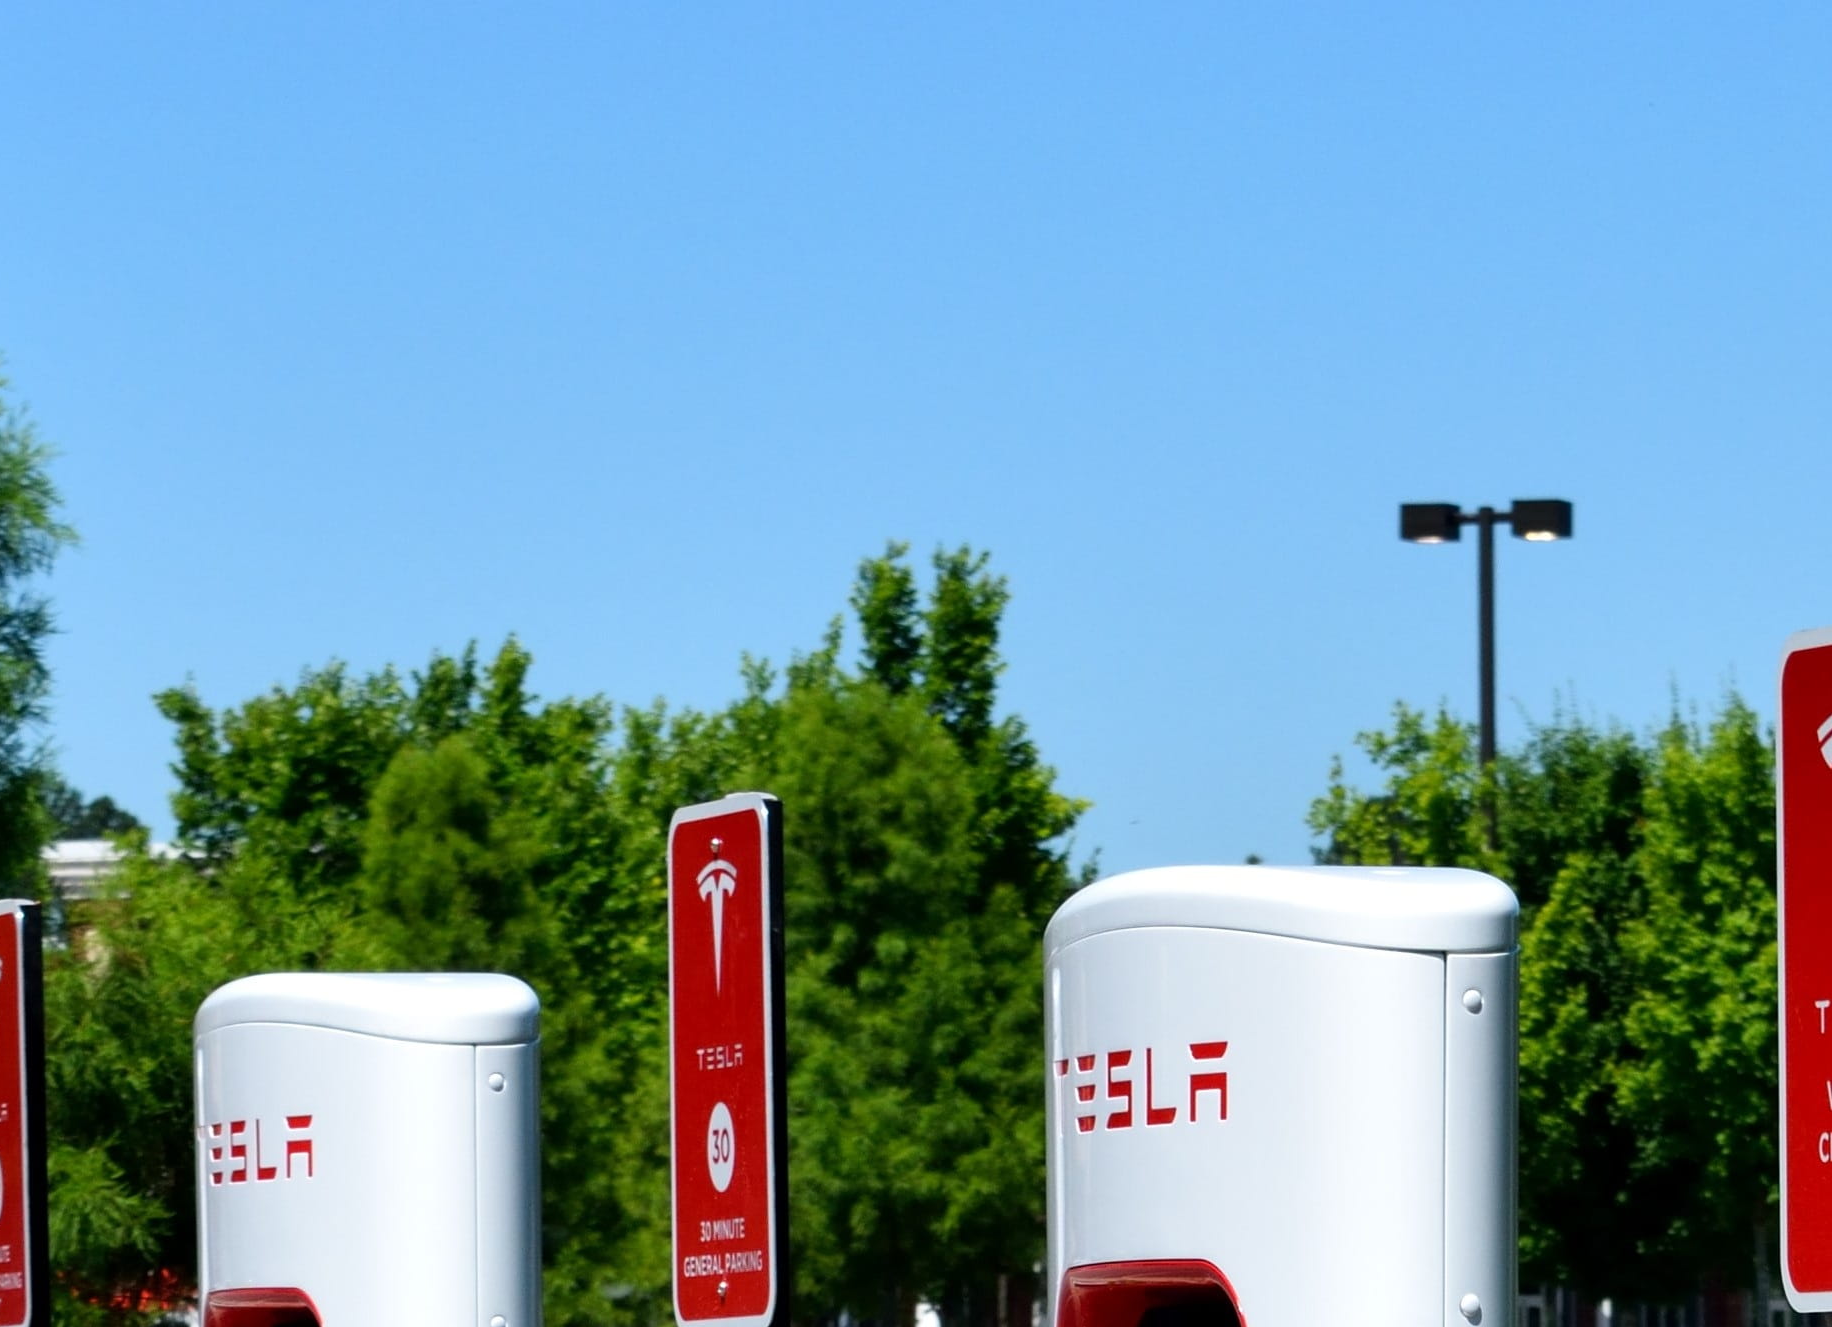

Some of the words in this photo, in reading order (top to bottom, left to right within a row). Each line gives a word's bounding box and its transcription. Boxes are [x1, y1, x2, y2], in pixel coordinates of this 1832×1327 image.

[696, 1043, 743, 1071] TESLA
[711, 1128, 731, 1165] 30
[699, 1220, 712, 1243] 30
[713, 1217, 746, 1241] MINUTE
[683, 1254, 725, 1278] GENERAL
[725, 1250, 763, 1275] PARKING
